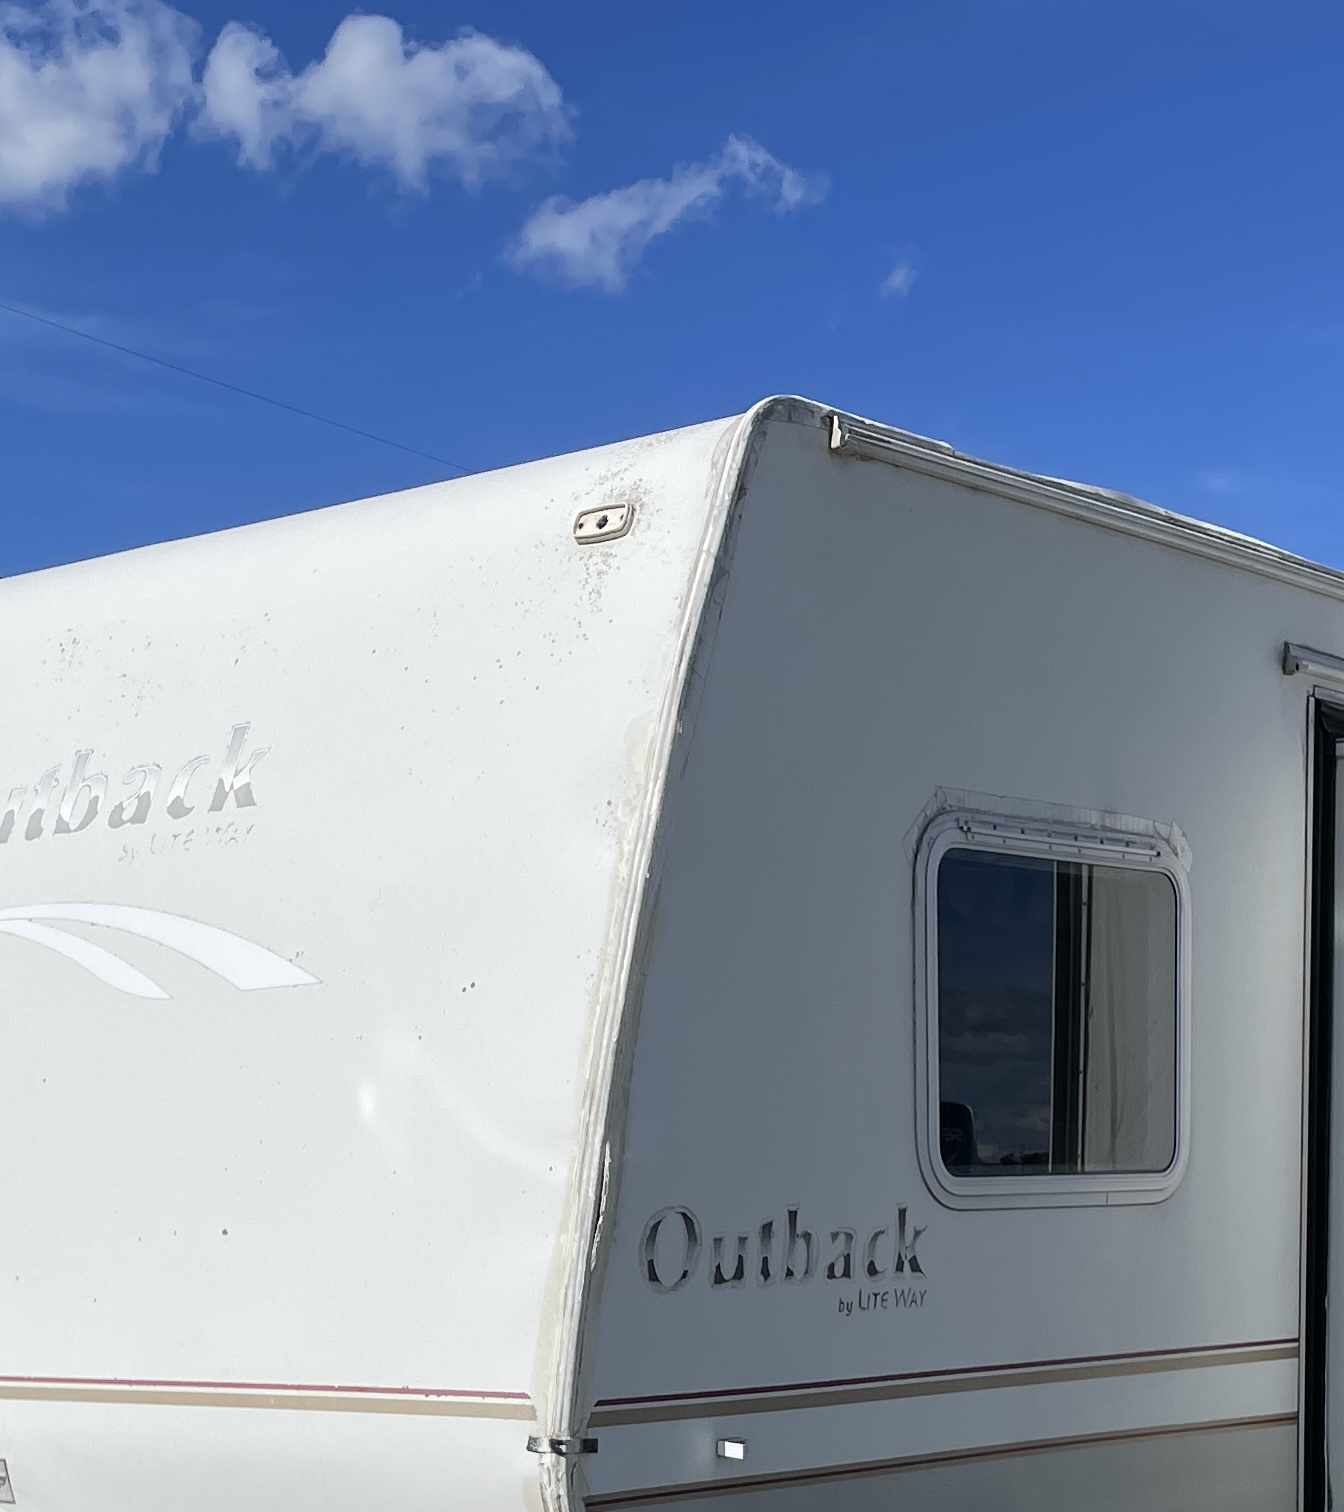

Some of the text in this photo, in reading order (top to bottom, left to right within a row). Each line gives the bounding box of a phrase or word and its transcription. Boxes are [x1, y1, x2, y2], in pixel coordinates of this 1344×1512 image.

[639, 1202, 928, 1292] Outback
[838, 1286, 928, 1317] by LITE WAY
